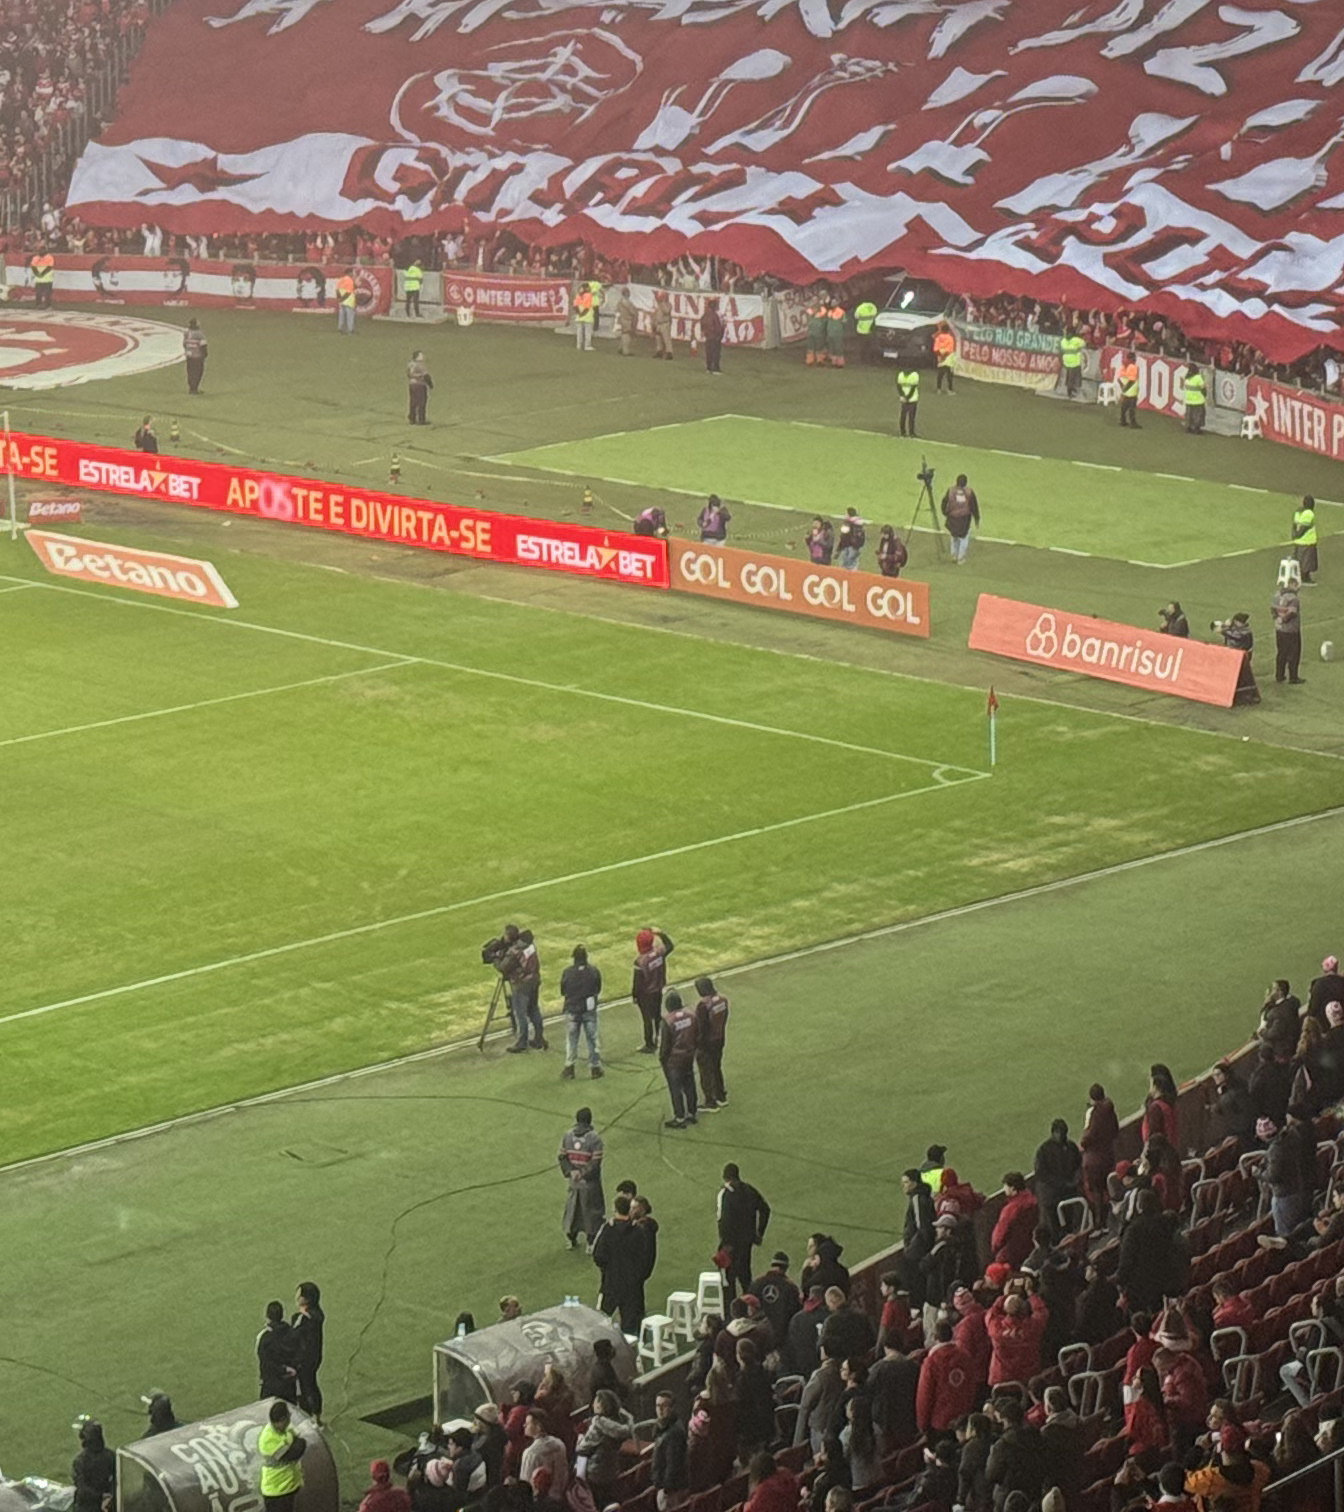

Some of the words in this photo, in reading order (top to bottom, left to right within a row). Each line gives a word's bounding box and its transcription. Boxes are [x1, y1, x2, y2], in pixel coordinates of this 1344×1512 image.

[476, 288, 513, 307] INTER
[991, 346, 1028, 368] NOSSO
[995, 328, 1014, 346] RIO
[1272, 390, 1328, 450] INTER
[29, 501, 81, 516] Betano
[226, 475, 324, 522] APOSTE
[329, 494, 345, 525] E
[350, 498, 492, 553] DIVIRTA-SE
[44, 540, 208, 596] Betano
[680, 550, 731, 589] GOL
[741, 562, 793, 601] GOL
[802, 574, 856, 613] GOL
[867, 585, 921, 625] GOL
[1061, 623, 1184, 682] banrisul
